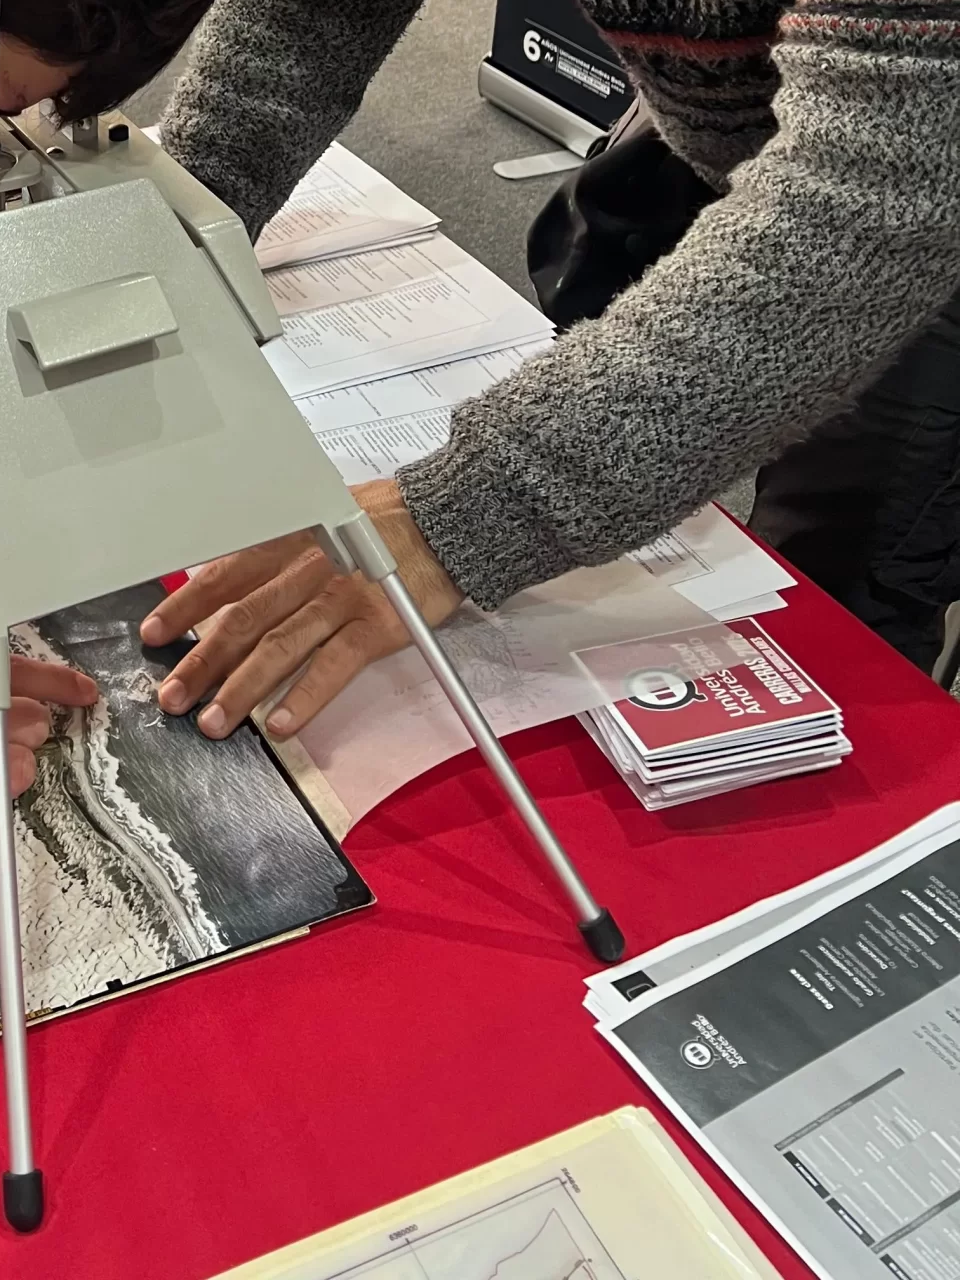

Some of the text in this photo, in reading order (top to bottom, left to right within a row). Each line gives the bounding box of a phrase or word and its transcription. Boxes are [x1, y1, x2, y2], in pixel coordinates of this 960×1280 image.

[523, 30, 541, 62] 6
[669, 642, 745, 717] Universidad
[714, 668, 766, 713] Andrés
[742, 656, 803, 705] CARRERAS
[899, 888, 946, 923] preguntas?
[787, 968, 834, 1010] Datos clave
[850, 975, 874, 996] Grado
[690, 1019, 739, 1068] Universidad
[715, 1035, 747, 1065] Andrés
